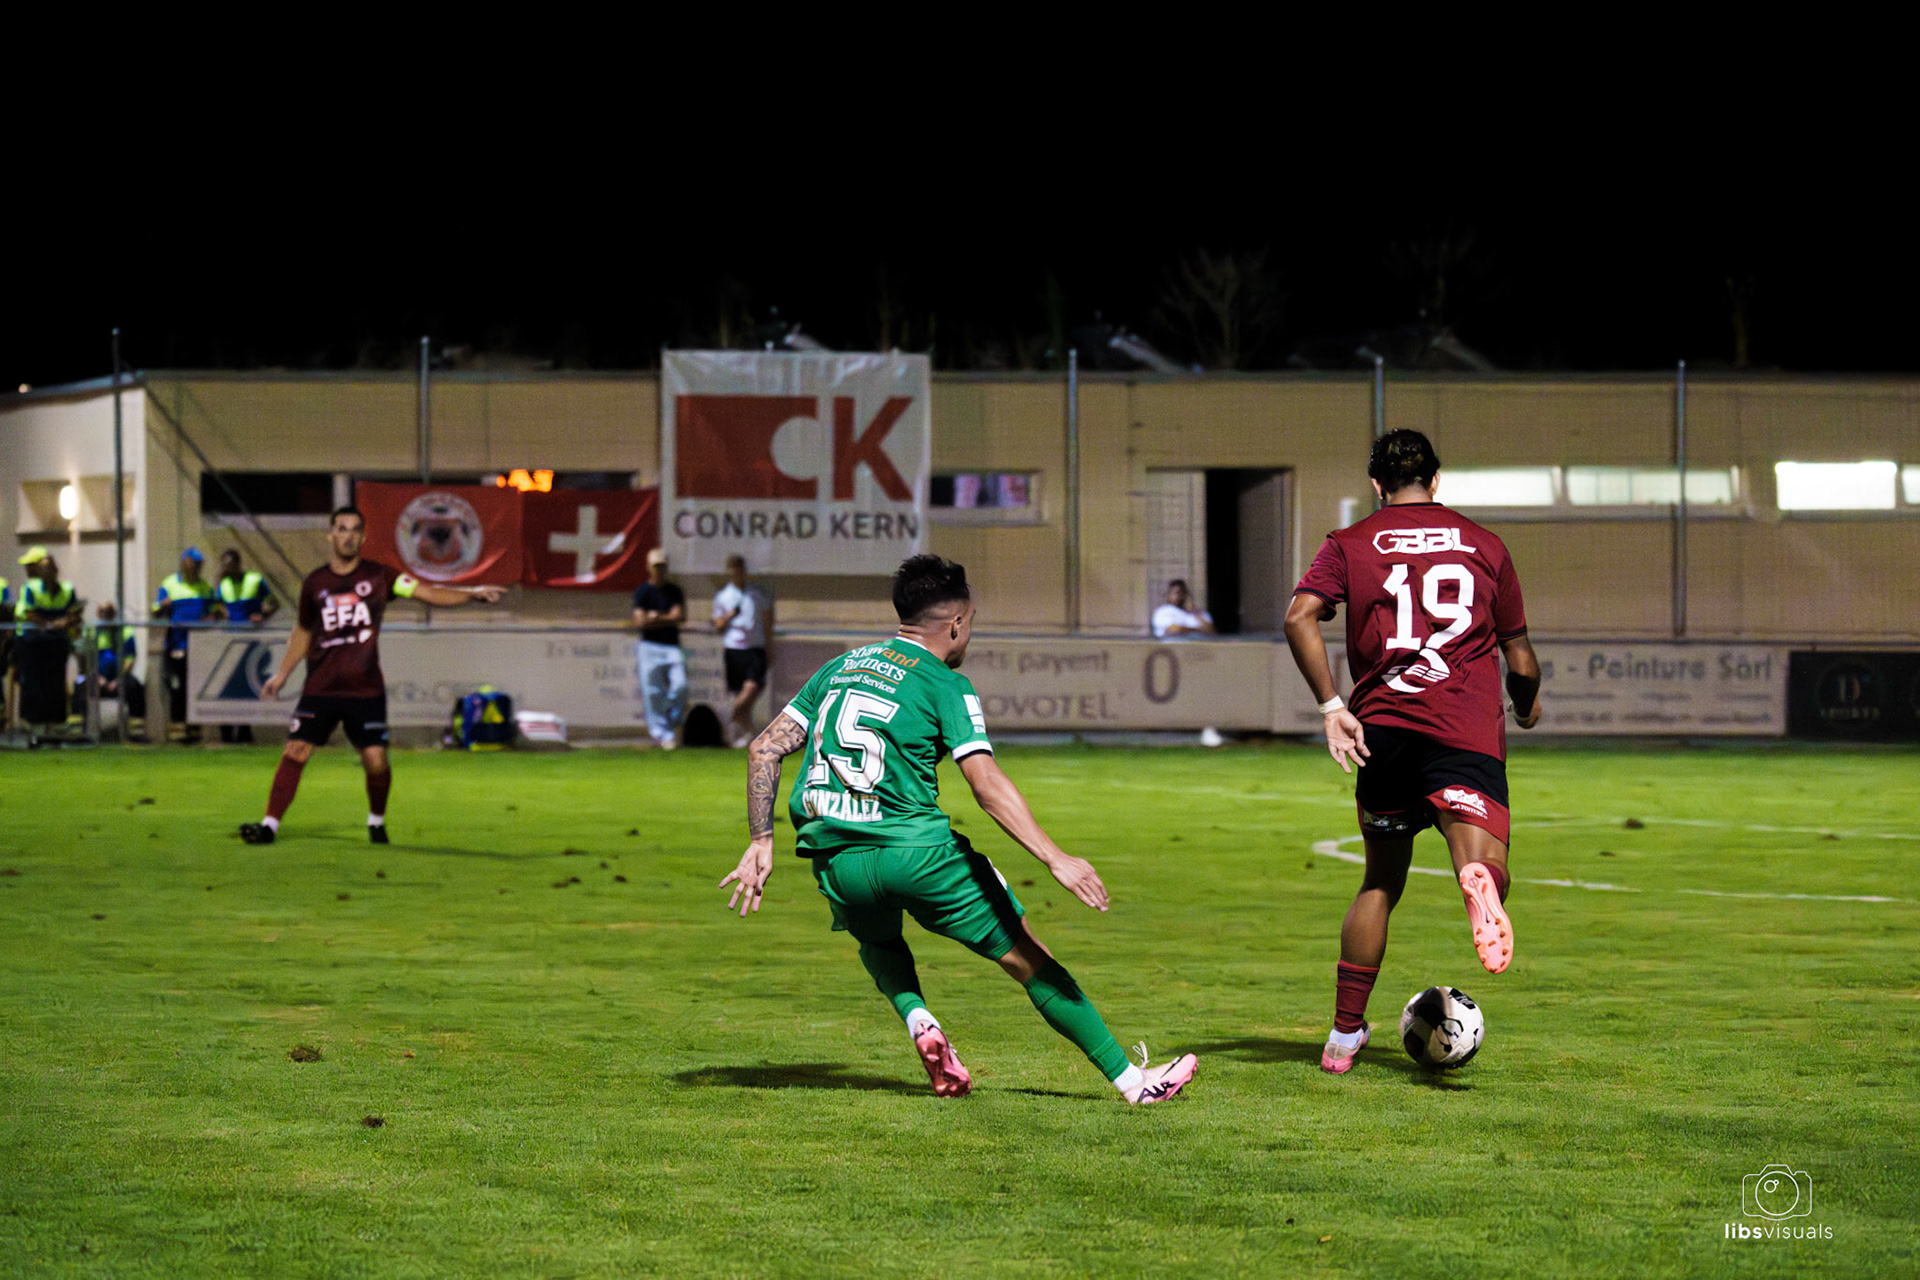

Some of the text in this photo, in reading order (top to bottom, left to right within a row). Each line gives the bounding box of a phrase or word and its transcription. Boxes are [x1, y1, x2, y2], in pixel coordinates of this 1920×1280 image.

[673, 509, 918, 538] CONRAD KERN
[1373, 528, 1476, 554] GBBL
[321, 601, 371, 631] EFA
[1382, 564, 1474, 650] 19
[837, 658, 907, 681] Partners
[861, 675, 897, 694] Services
[983, 692, 1119, 719] OVOTEL
[805, 688, 900, 793] 15
